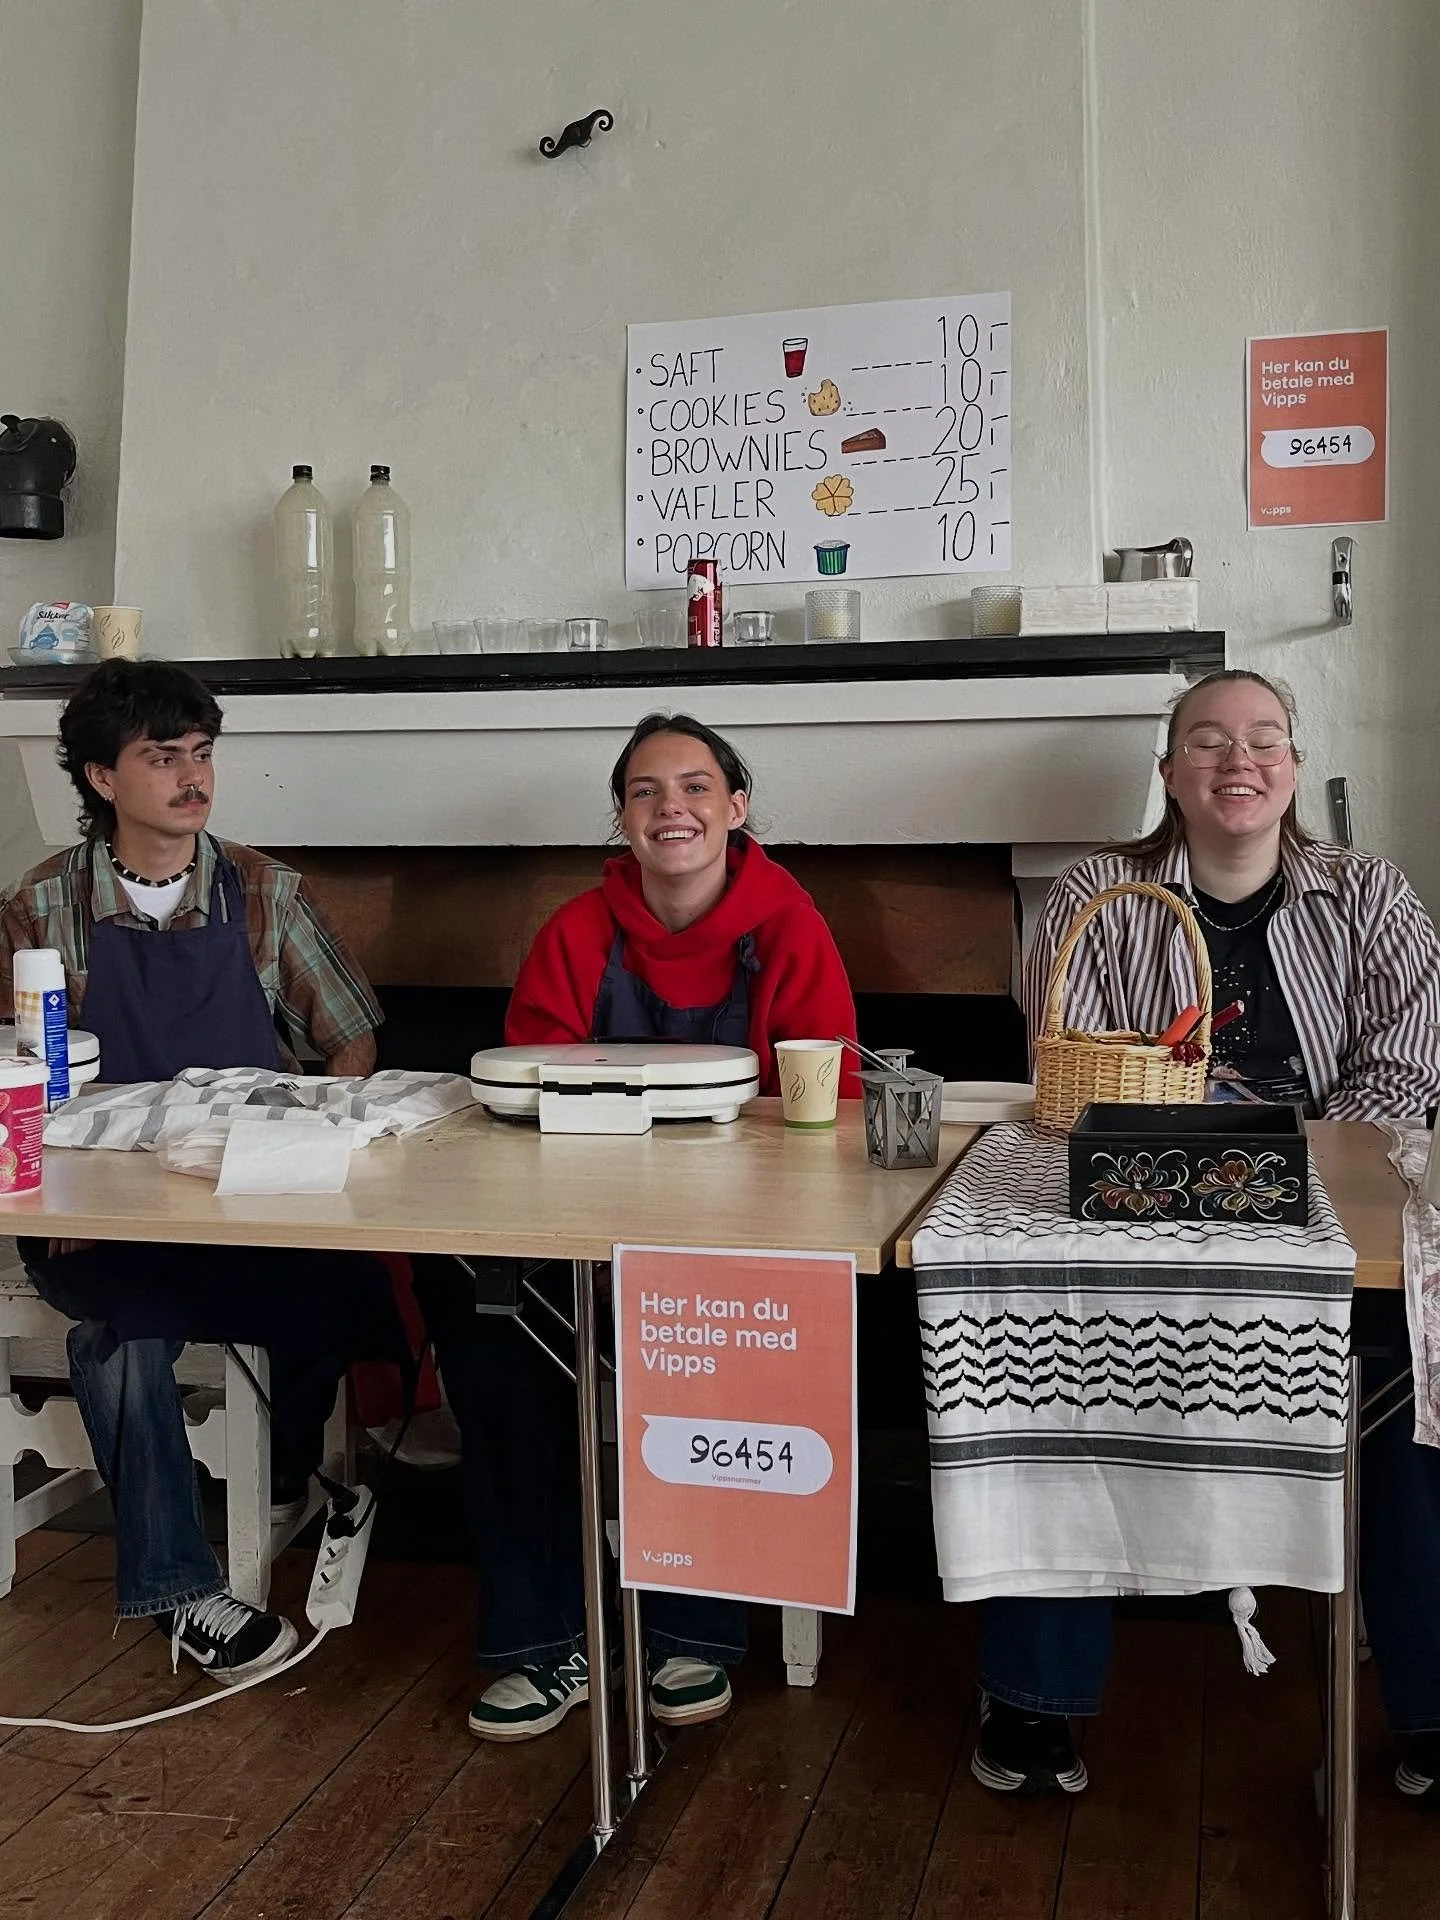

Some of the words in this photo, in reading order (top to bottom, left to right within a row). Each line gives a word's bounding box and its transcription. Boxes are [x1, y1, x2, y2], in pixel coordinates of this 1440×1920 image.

[650, 348, 724, 386] SAFT
[1261, 361, 1290, 374] Her
[1294, 359, 1324, 372] kan
[1328, 357, 1350, 370] du
[1261, 376, 1313, 390] betale
[1317, 372, 1355, 387] med
[650, 389, 786, 432] COOKIES
[1261, 392, 1307, 408] Vipps
[651, 429, 828, 477] BROWNIES
[1289, 434, 1352, 456] 96454
[651, 479, 776, 521] VAFLER
[655, 531, 786, 573] POPCORN
[640, 1291, 687, 1317] Her
[695, 1294, 745, 1319] kan
[753, 1297, 790, 1321] du
[641, 1320, 728, 1347] betale
[735, 1327, 798, 1351] med
[641, 1347, 717, 1378] Vipps
[690, 1435, 793, 1474] 96454
[711, 1473, 762, 1485] Vippsnummer
